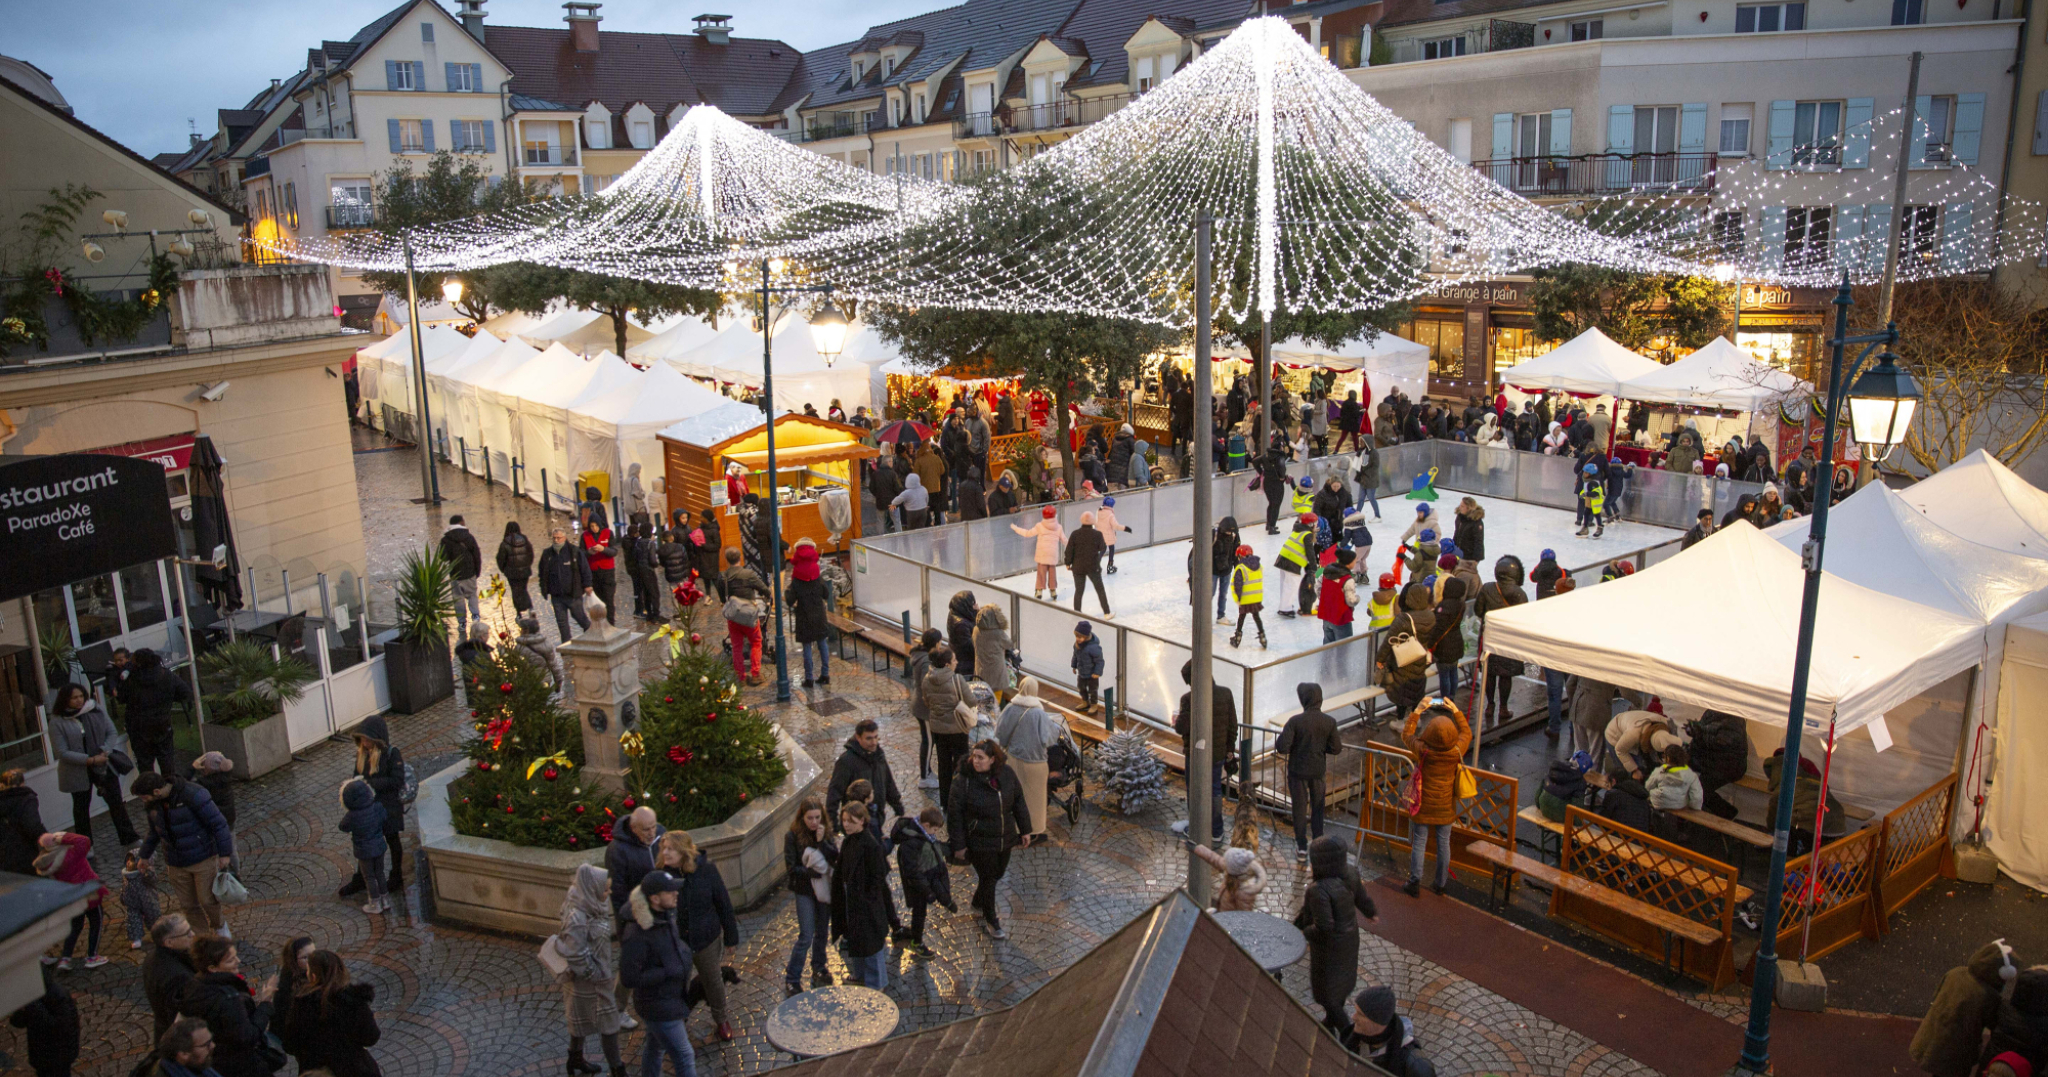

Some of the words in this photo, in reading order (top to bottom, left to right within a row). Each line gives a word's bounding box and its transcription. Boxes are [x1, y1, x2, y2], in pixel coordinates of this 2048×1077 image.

[1442, 286, 1480, 304] Grange
[1483, 285, 1490, 300] à
[1492, 288, 1517, 305] pain
[1746, 288, 1755, 304] à
[1760, 290, 1791, 308] pain
[0, 467, 118, 510] staurant
[8, 503, 91, 534] ParadoXe
[58, 519, 95, 540] Café
